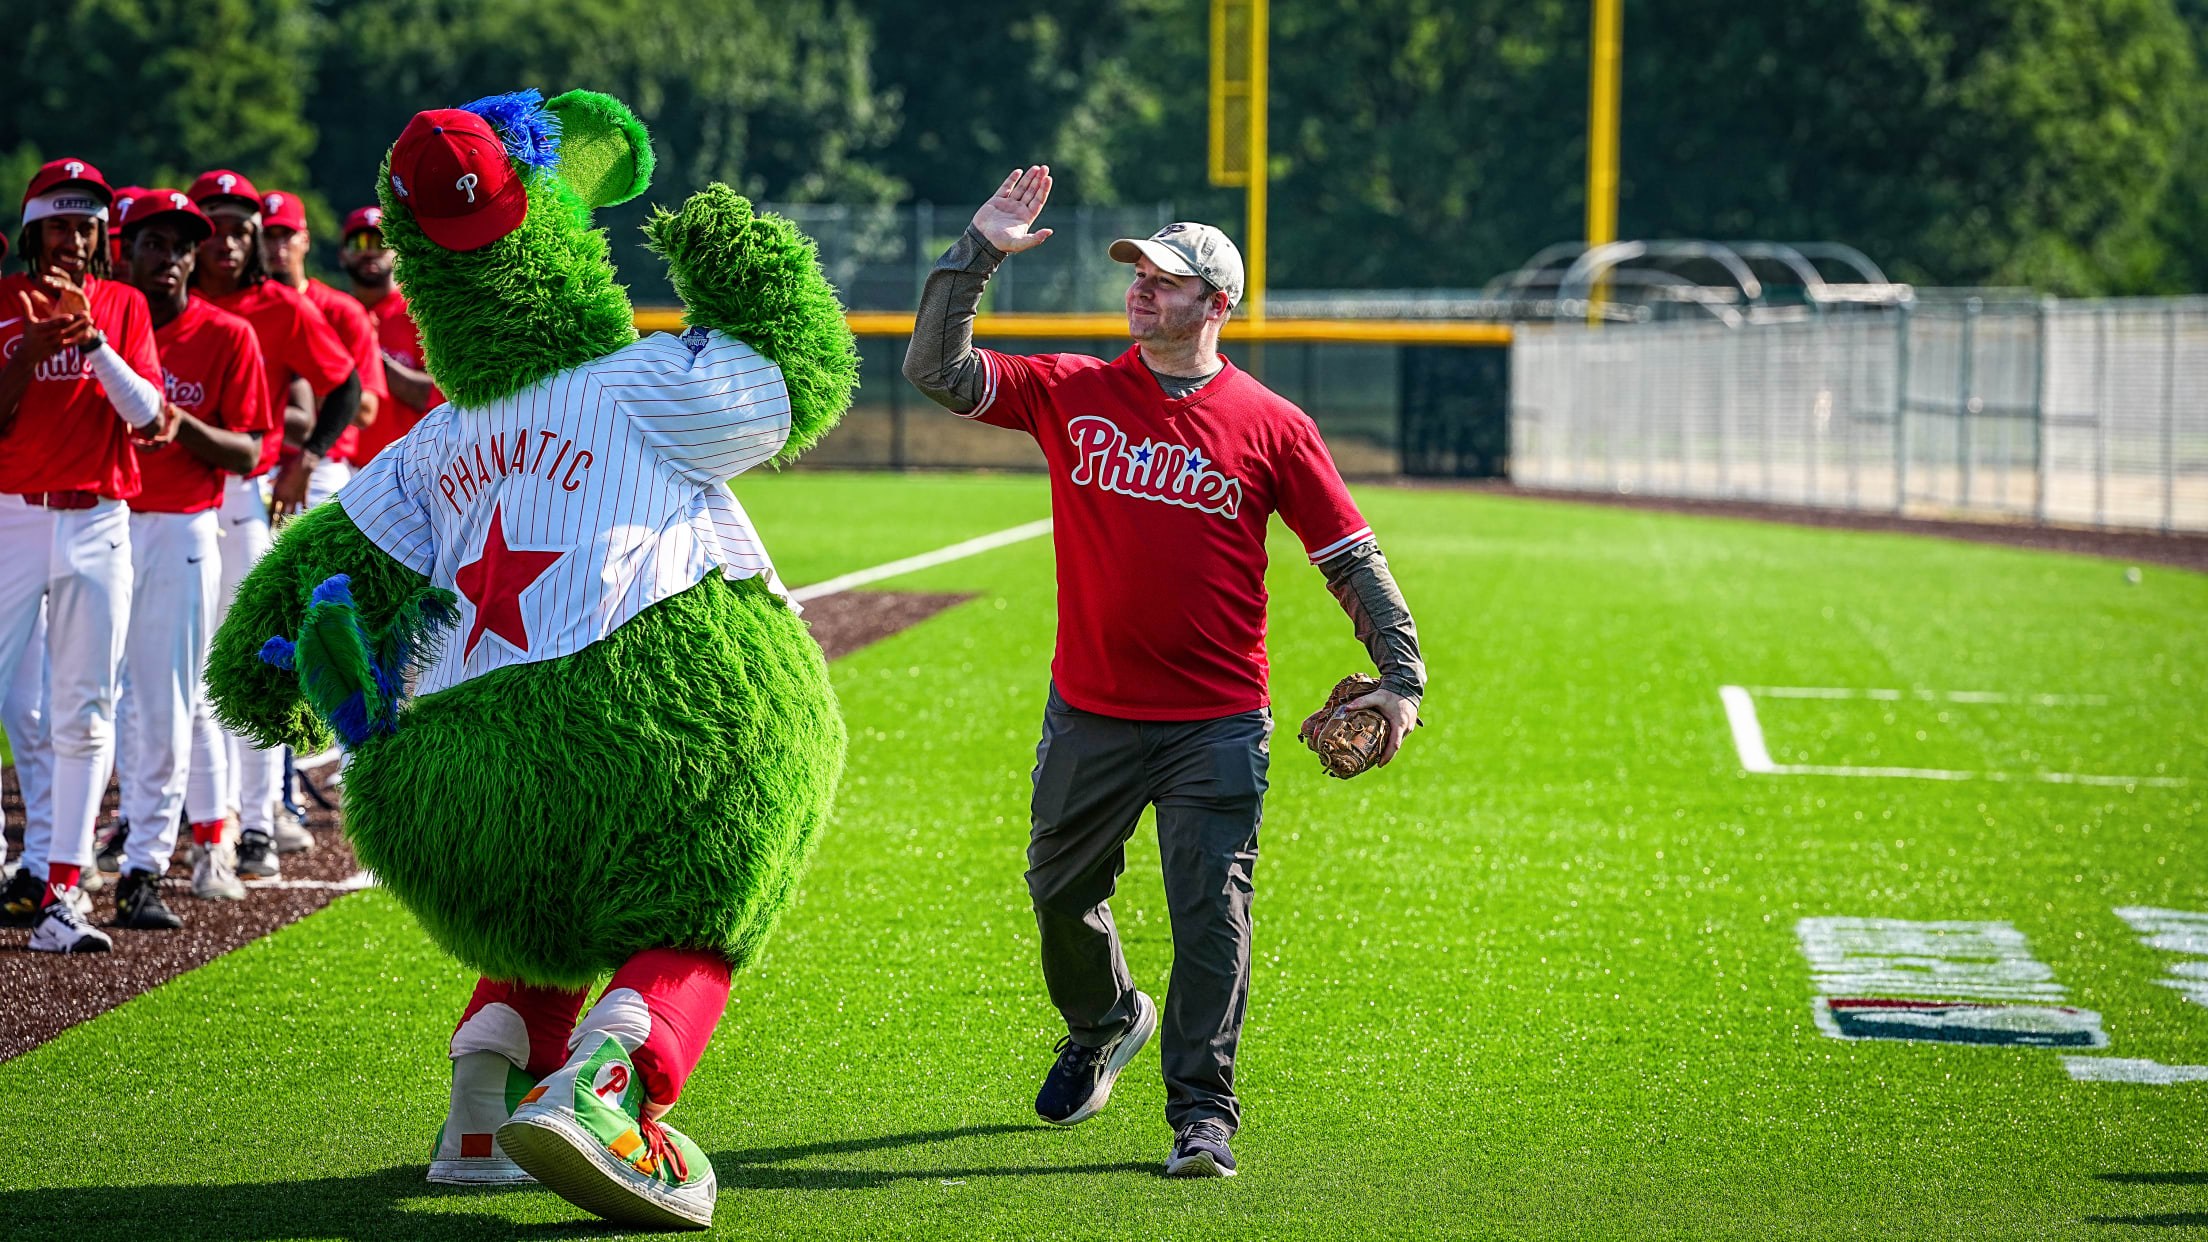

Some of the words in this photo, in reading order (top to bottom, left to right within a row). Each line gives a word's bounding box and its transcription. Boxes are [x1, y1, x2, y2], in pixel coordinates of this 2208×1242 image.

[64, 162, 84, 179] P
[217, 174, 237, 194] P
[456, 173, 478, 203] P
[439, 428, 594, 516] PHANATIC
[1067, 415, 1243, 520] Phillies
[595, 1064, 629, 1099] P
